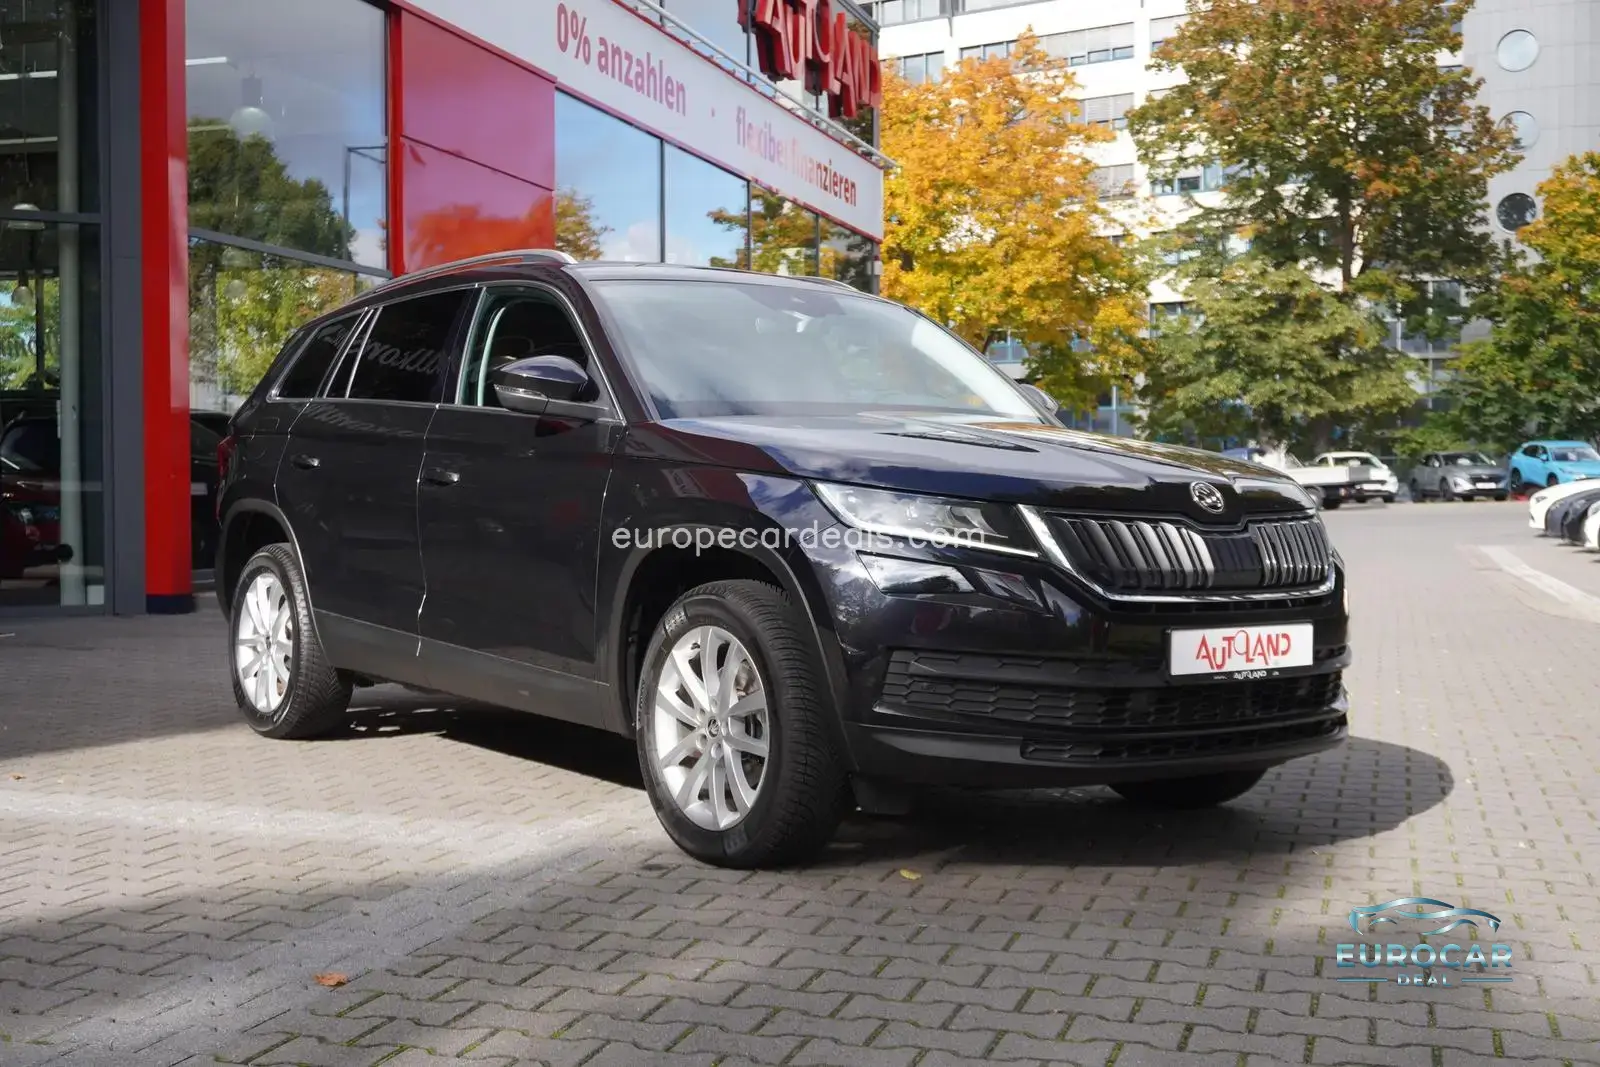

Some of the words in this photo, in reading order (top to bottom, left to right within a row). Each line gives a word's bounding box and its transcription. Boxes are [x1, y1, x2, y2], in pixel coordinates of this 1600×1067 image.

[556, 2, 592, 66] 0%
[597, 36, 687, 117] anzahlen
[790, 136, 858, 207] finanzieren
[1195, 629, 1292, 670] AUTOLAND
